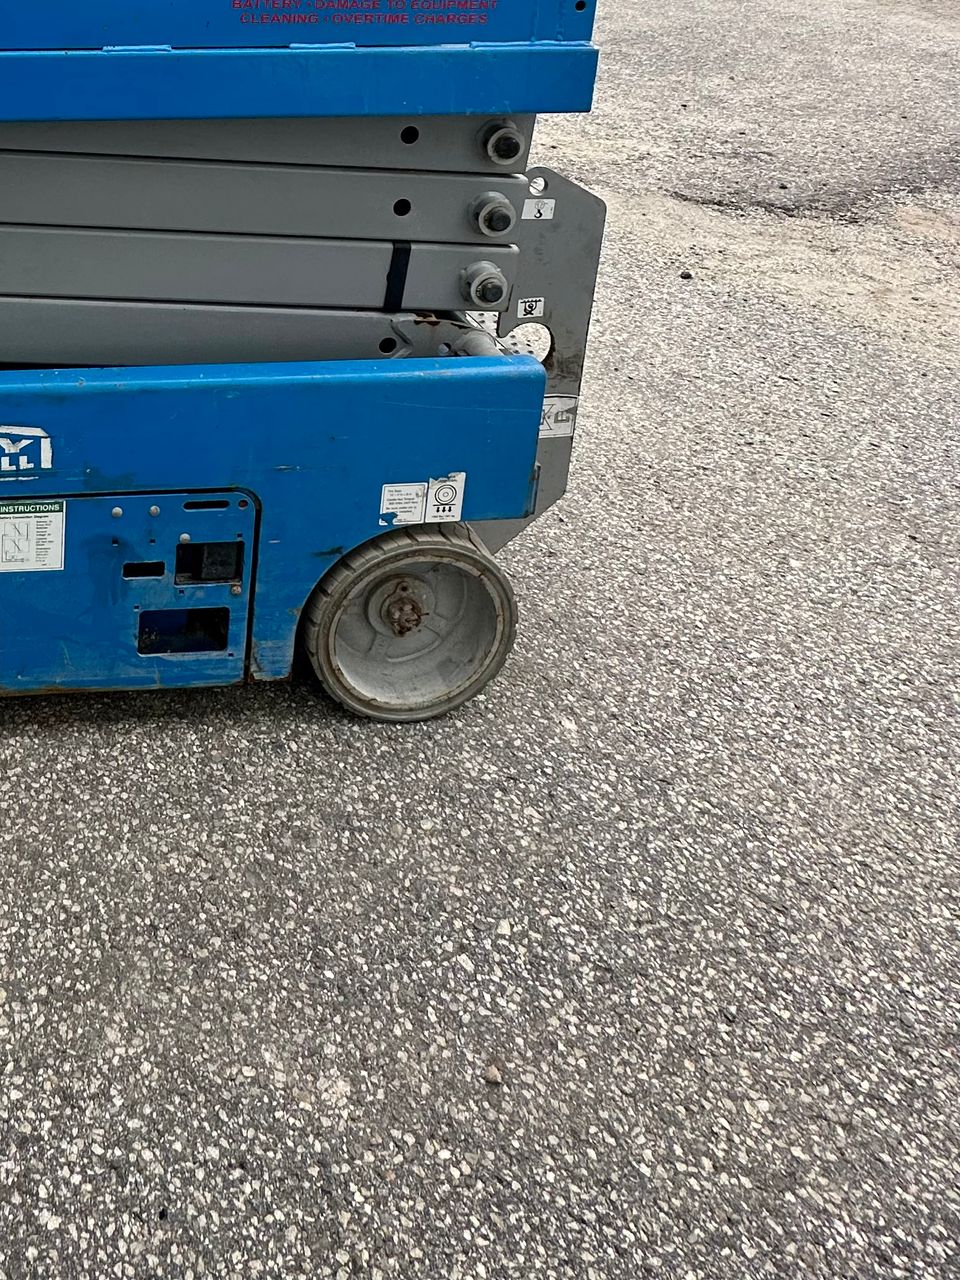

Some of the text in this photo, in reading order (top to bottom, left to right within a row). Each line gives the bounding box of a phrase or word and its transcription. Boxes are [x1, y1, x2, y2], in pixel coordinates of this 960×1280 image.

[240, 13, 488, 24] CLEANING OVERTIME CHARGES
[0, 504, 60, 513] INSTRUCTIONS
